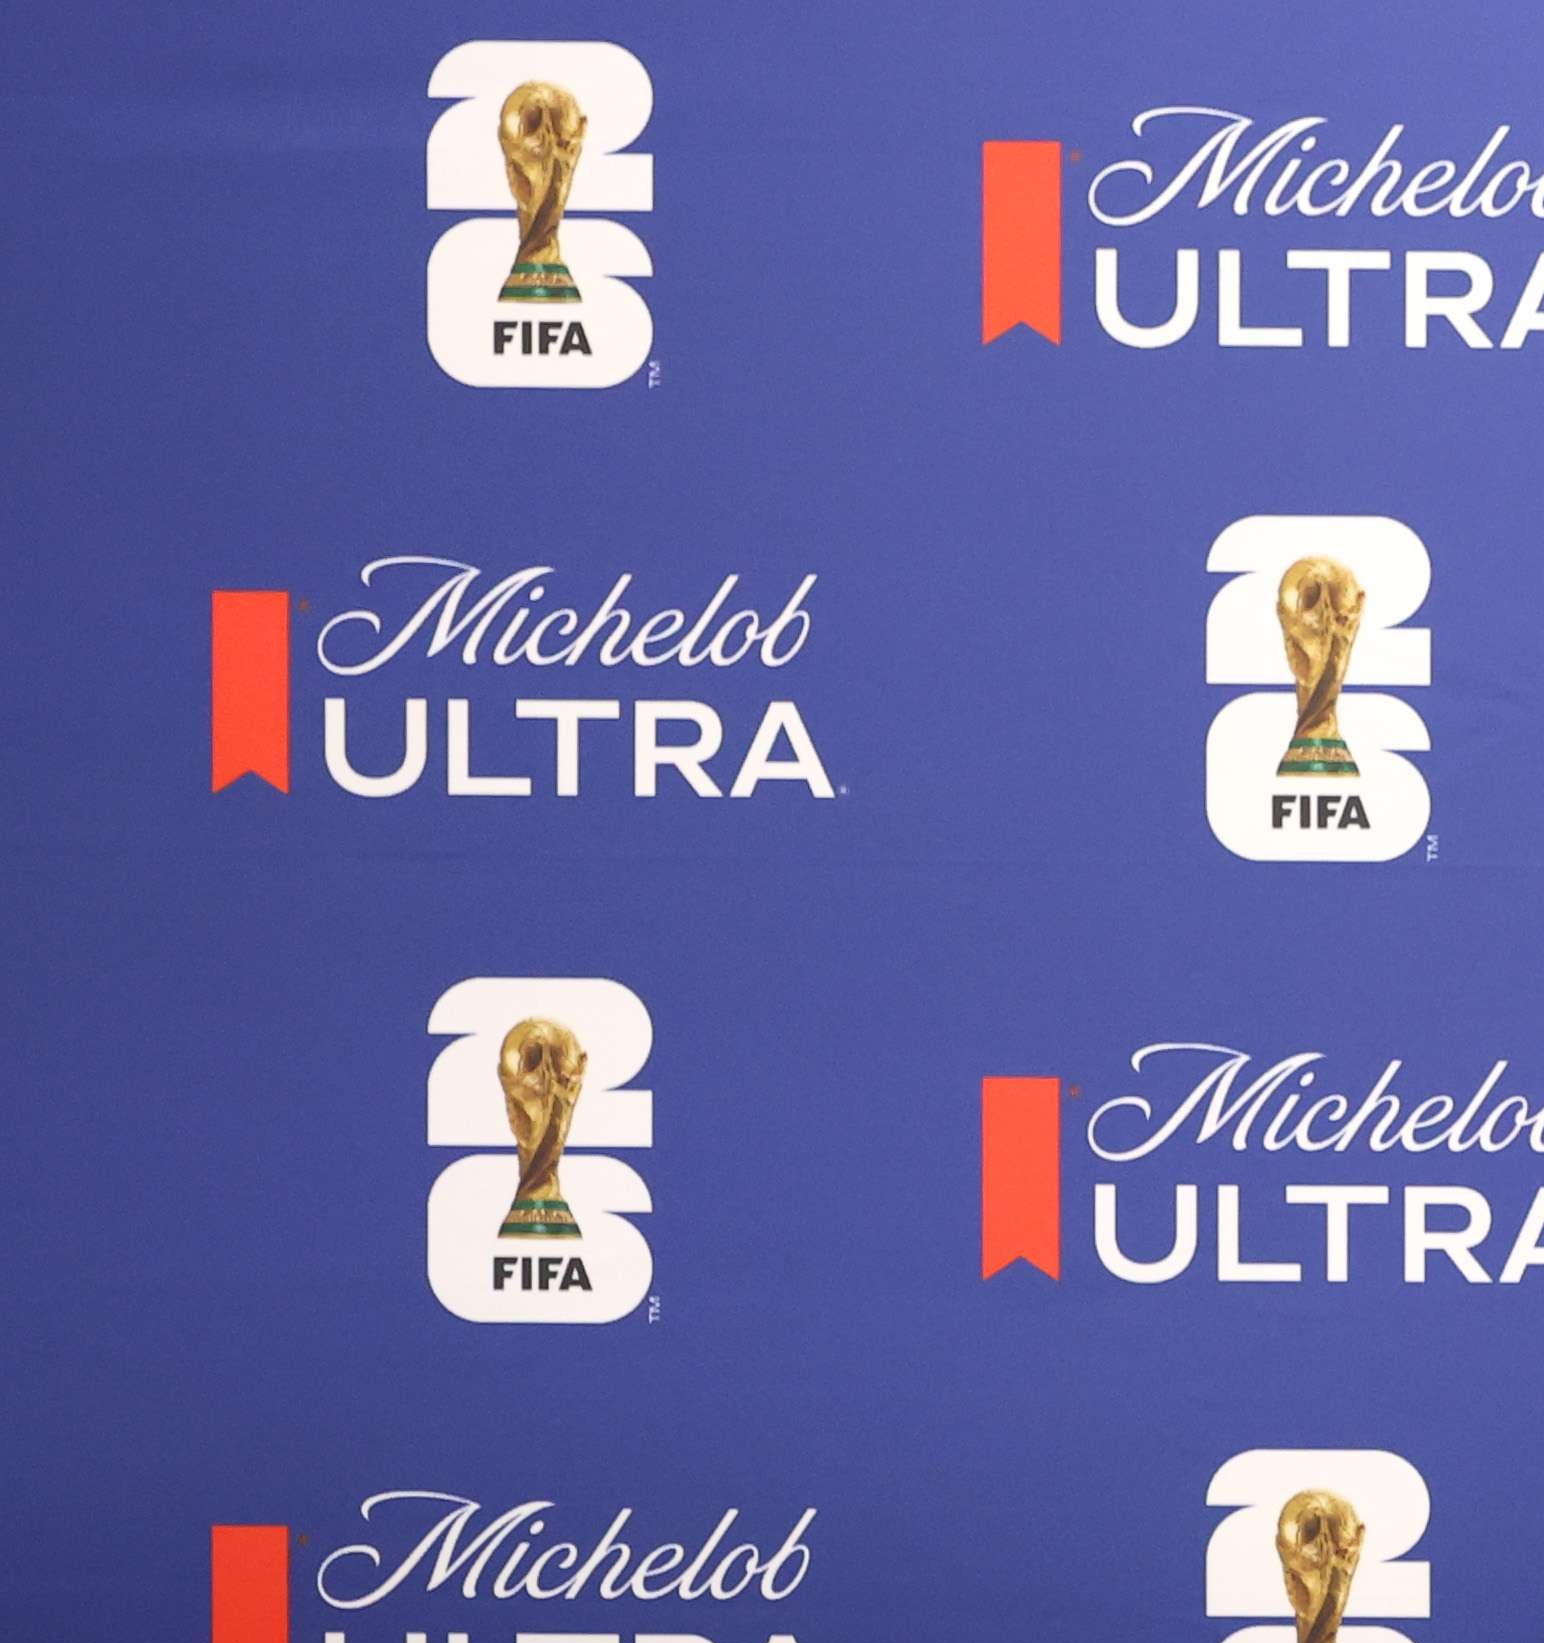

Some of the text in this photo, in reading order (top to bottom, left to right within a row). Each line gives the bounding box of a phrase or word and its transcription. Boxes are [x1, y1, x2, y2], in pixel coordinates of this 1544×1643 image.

[494, 322, 591, 354] FIFA
[317, 556, 817, 675] Michelob
[325, 698, 834, 798] ULTRA
[1273, 796, 1369, 828] FIFA
[494, 1258, 591, 1290] FIFA
[318, 1491, 816, 1608] Michelob
